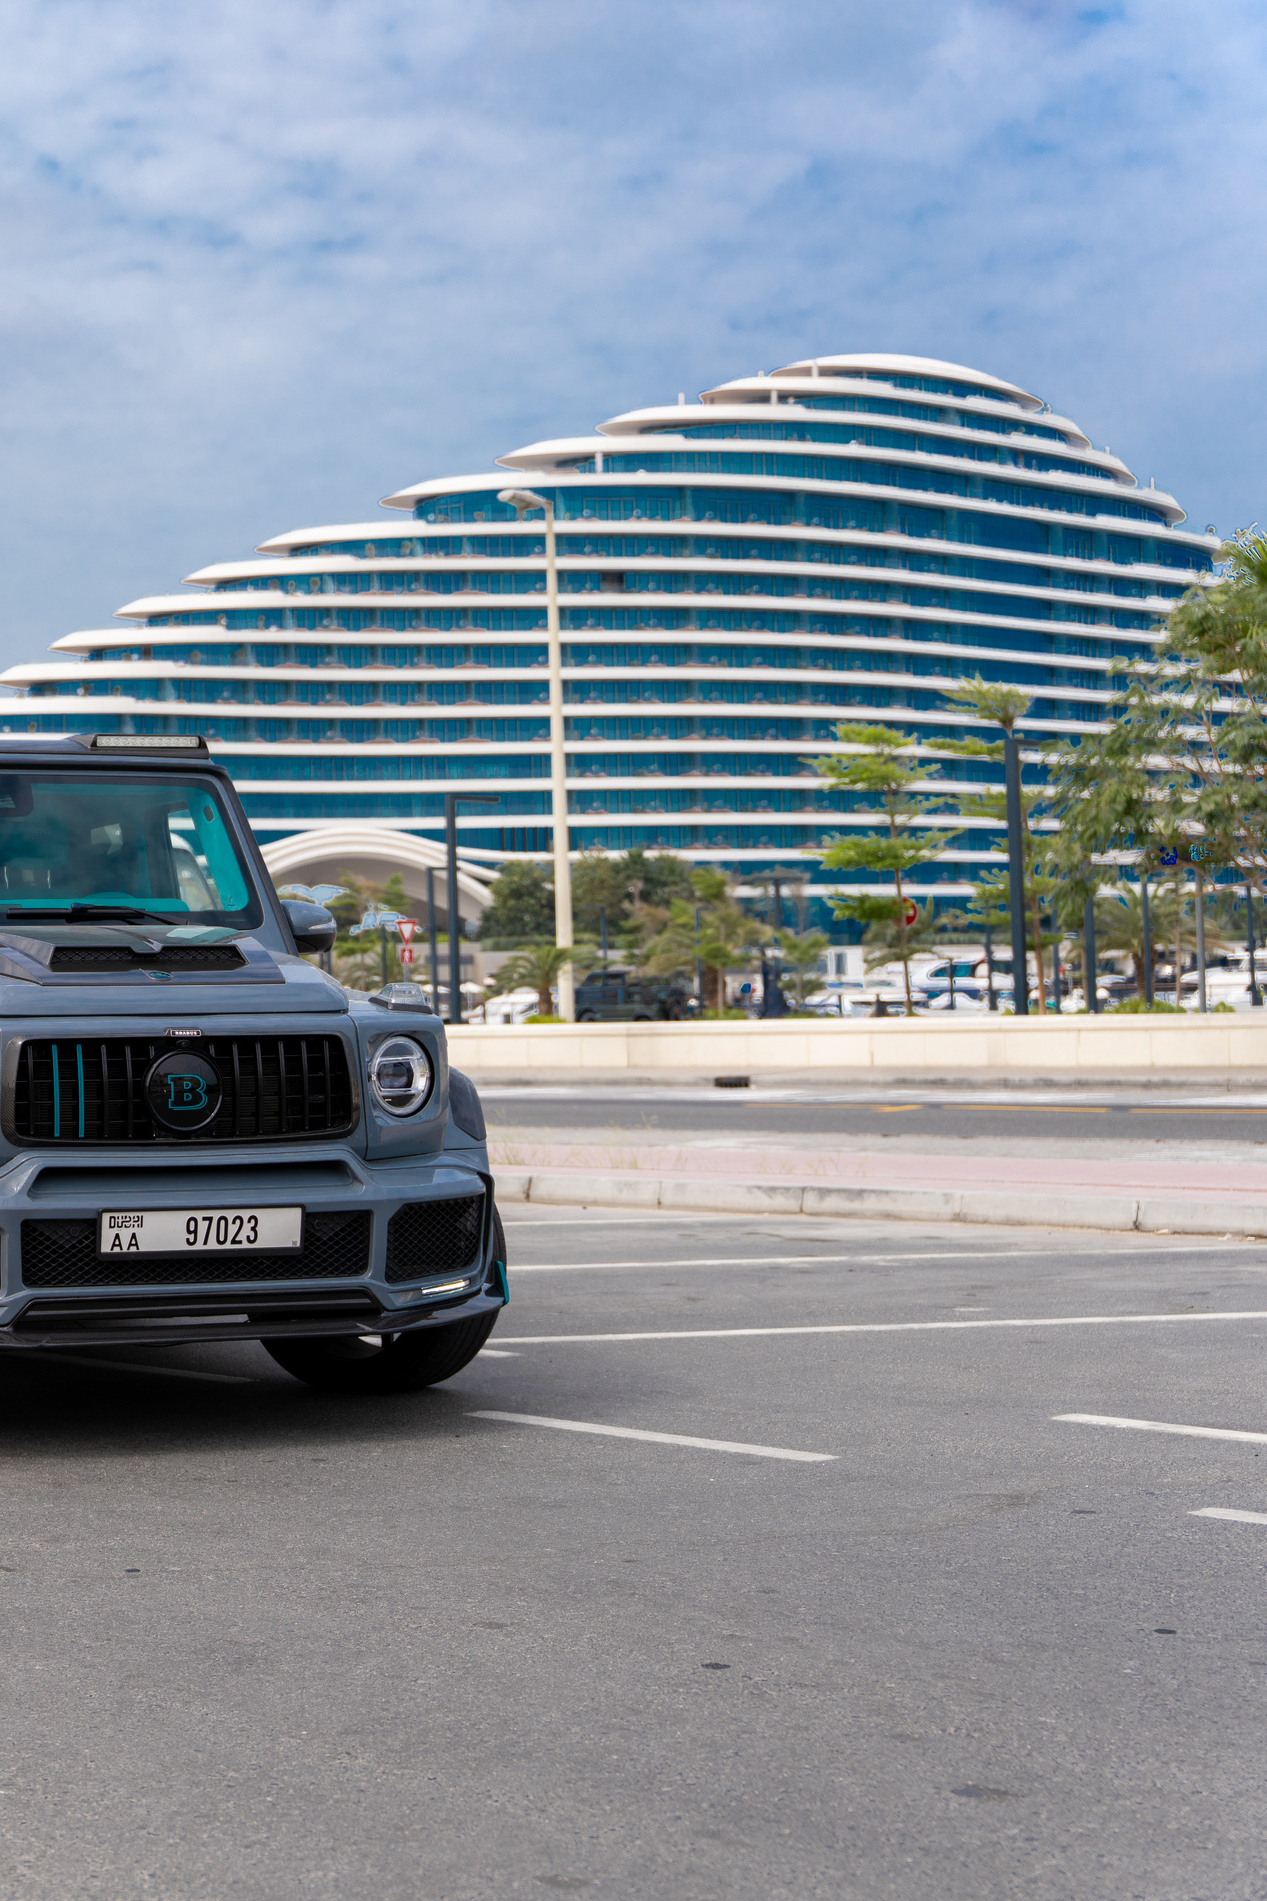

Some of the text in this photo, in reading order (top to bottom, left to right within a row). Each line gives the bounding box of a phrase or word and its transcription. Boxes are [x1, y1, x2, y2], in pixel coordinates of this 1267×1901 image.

[168, 1074, 208, 1110] B
[108, 1214, 144, 1229] DUBAI
[185, 1215, 259, 1246] 97023
